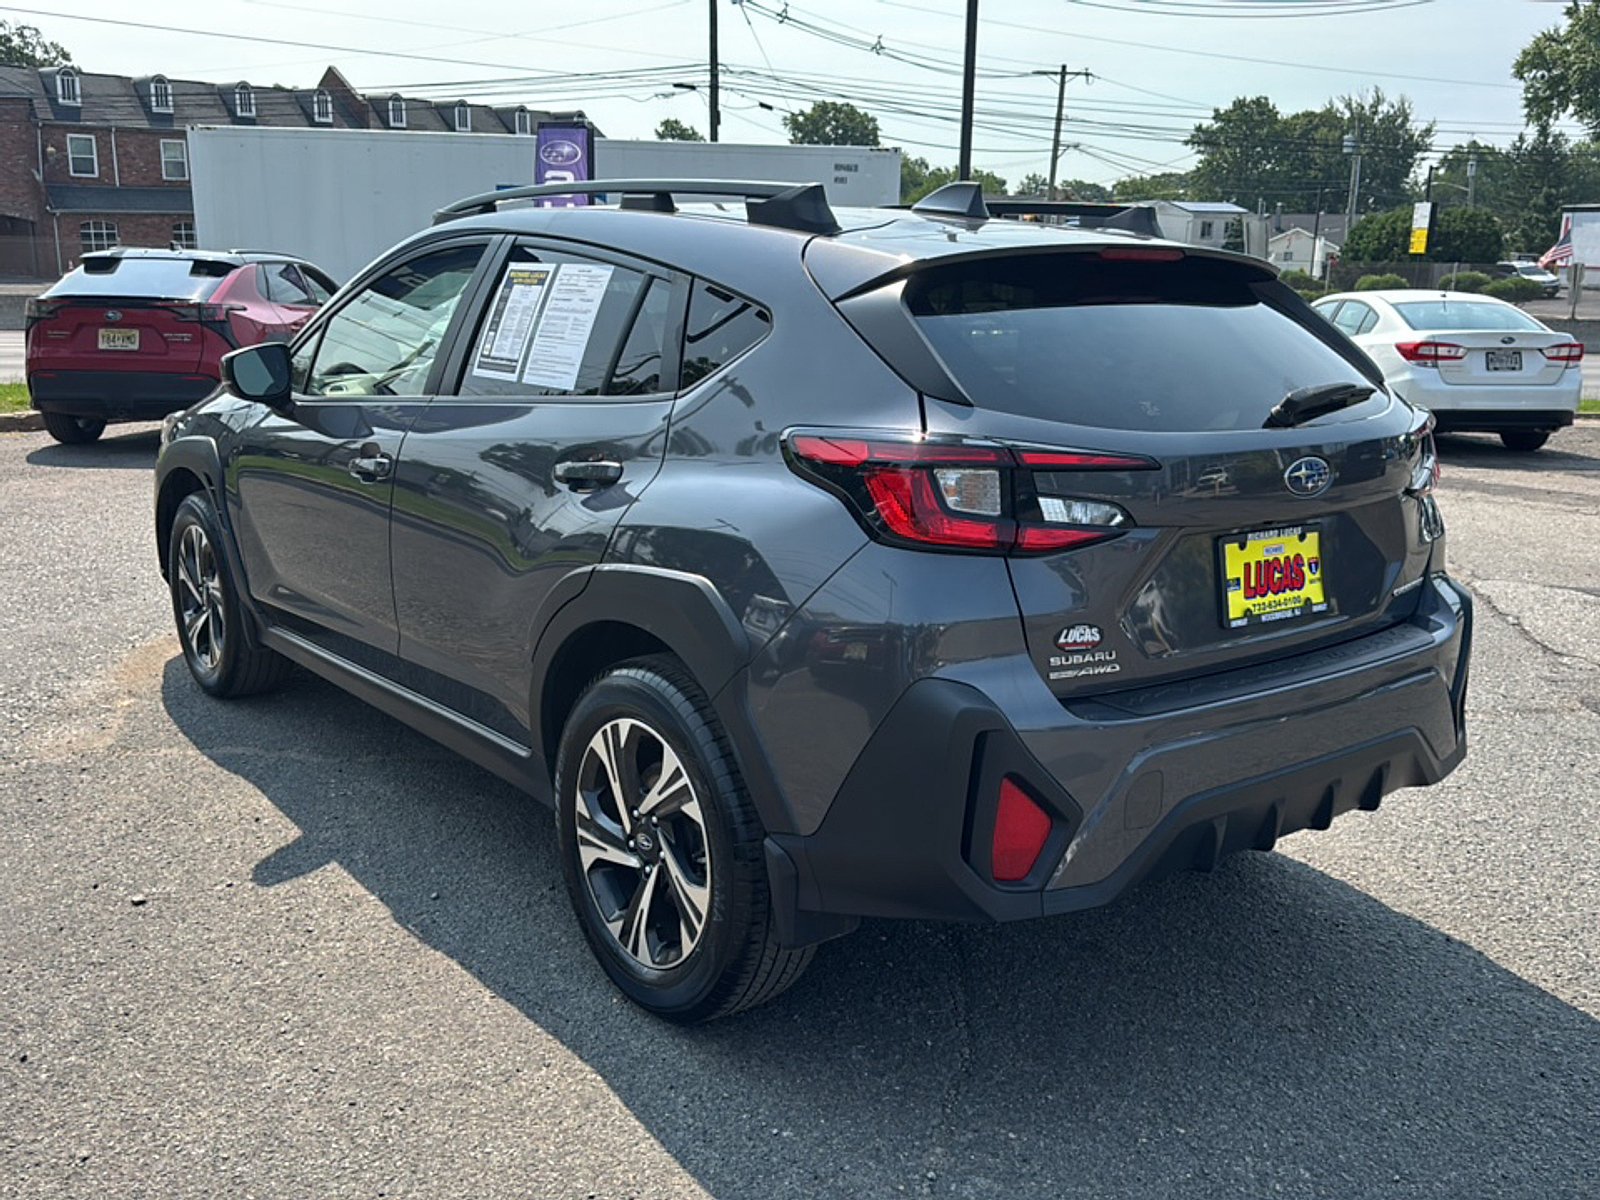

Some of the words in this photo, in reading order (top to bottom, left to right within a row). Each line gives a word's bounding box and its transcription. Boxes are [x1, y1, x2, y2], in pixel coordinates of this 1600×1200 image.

[1244, 553, 1305, 600] LUCAS
[1058, 628, 1100, 643] LUCAS
[1049, 650, 1117, 666] SUBARU
[1078, 663, 1121, 677] AWD
